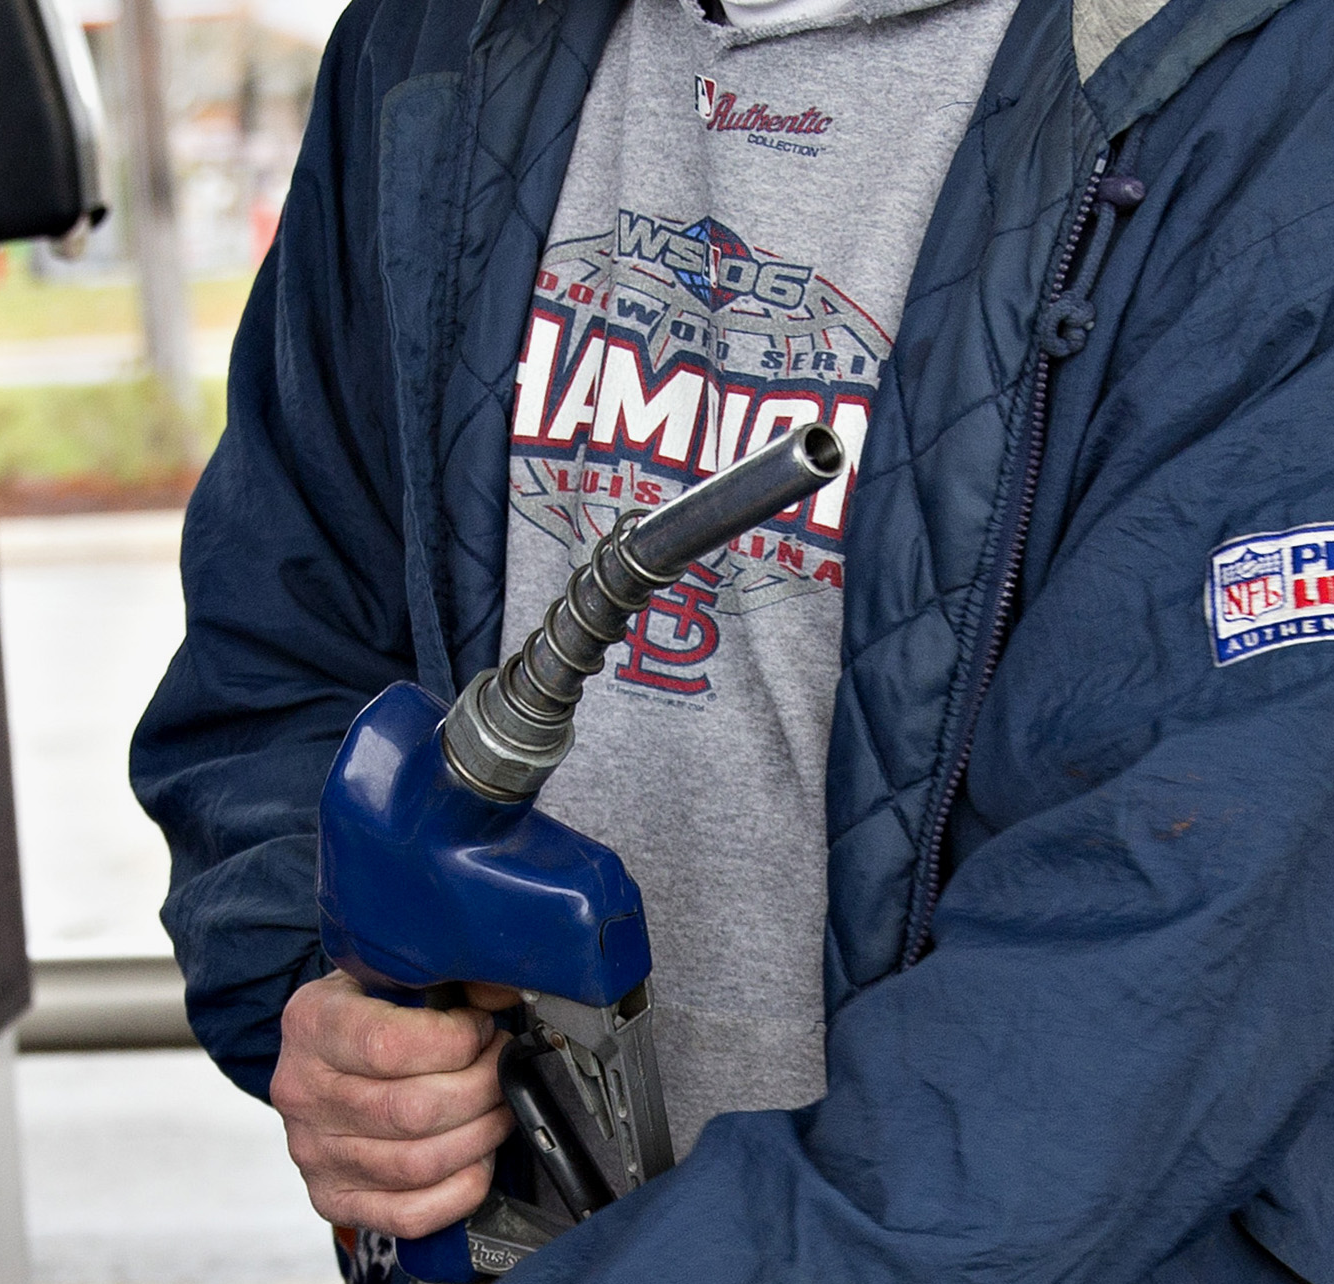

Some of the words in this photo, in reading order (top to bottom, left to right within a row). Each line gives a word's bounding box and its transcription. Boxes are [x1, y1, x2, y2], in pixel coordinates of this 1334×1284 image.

[707, 92, 833, 134] Authentic
[747, 133, 819, 158] COLLECTION
[618, 208, 707, 272] WS
[716, 257, 814, 310] 06
[536, 270, 609, 312] 00
[1223, 576, 1284, 618] NFL
